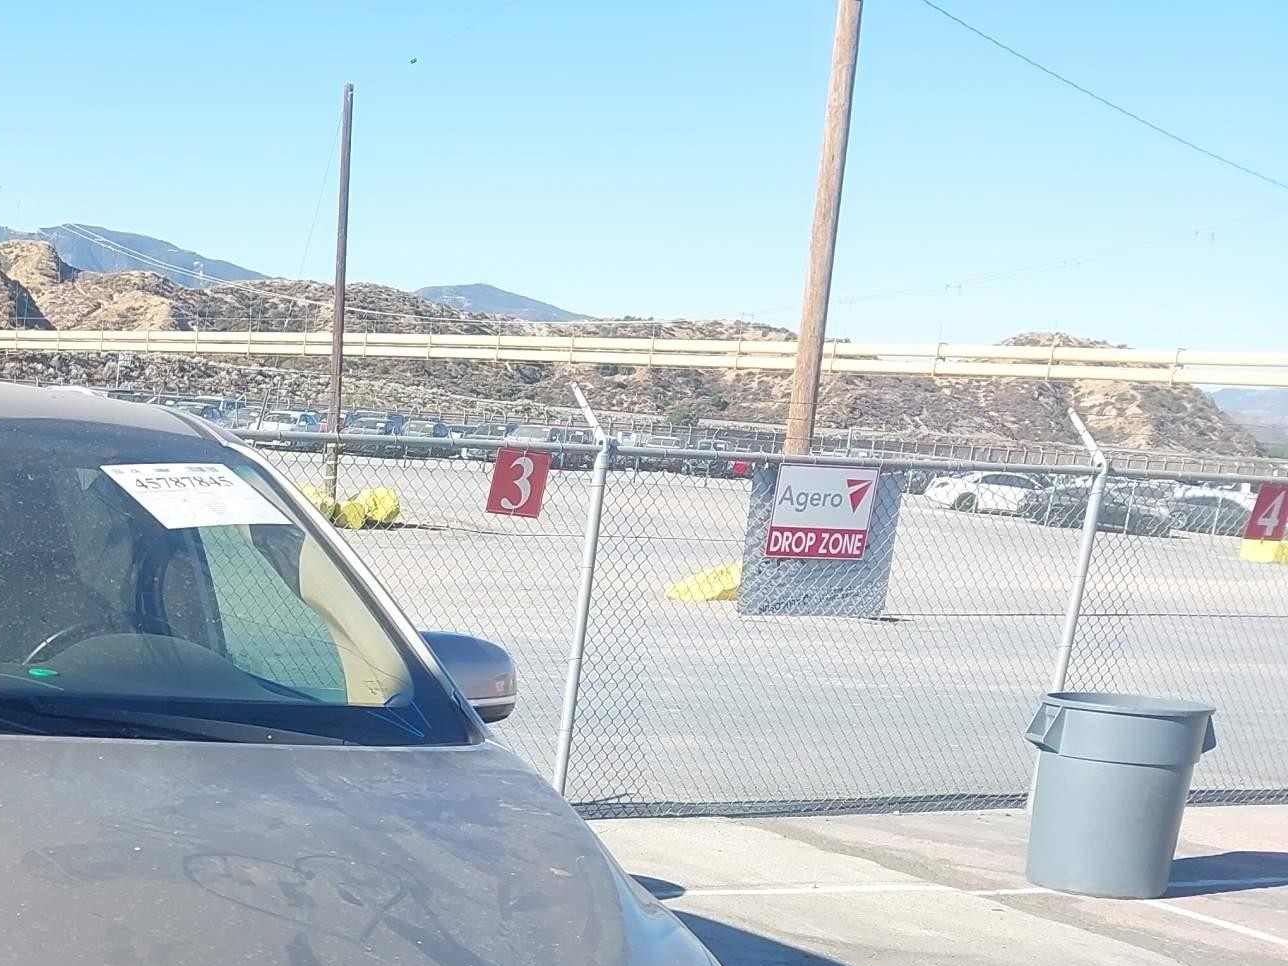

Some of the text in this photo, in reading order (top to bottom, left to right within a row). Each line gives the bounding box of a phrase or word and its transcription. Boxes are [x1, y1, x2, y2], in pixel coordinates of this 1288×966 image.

[135, 476, 234, 490] 45787845
[500, 456, 534, 510] 3
[778, 485, 843, 513] Agero
[1256, 490, 1287, 536] 4
[769, 530, 864, 555] DROP ZONE
